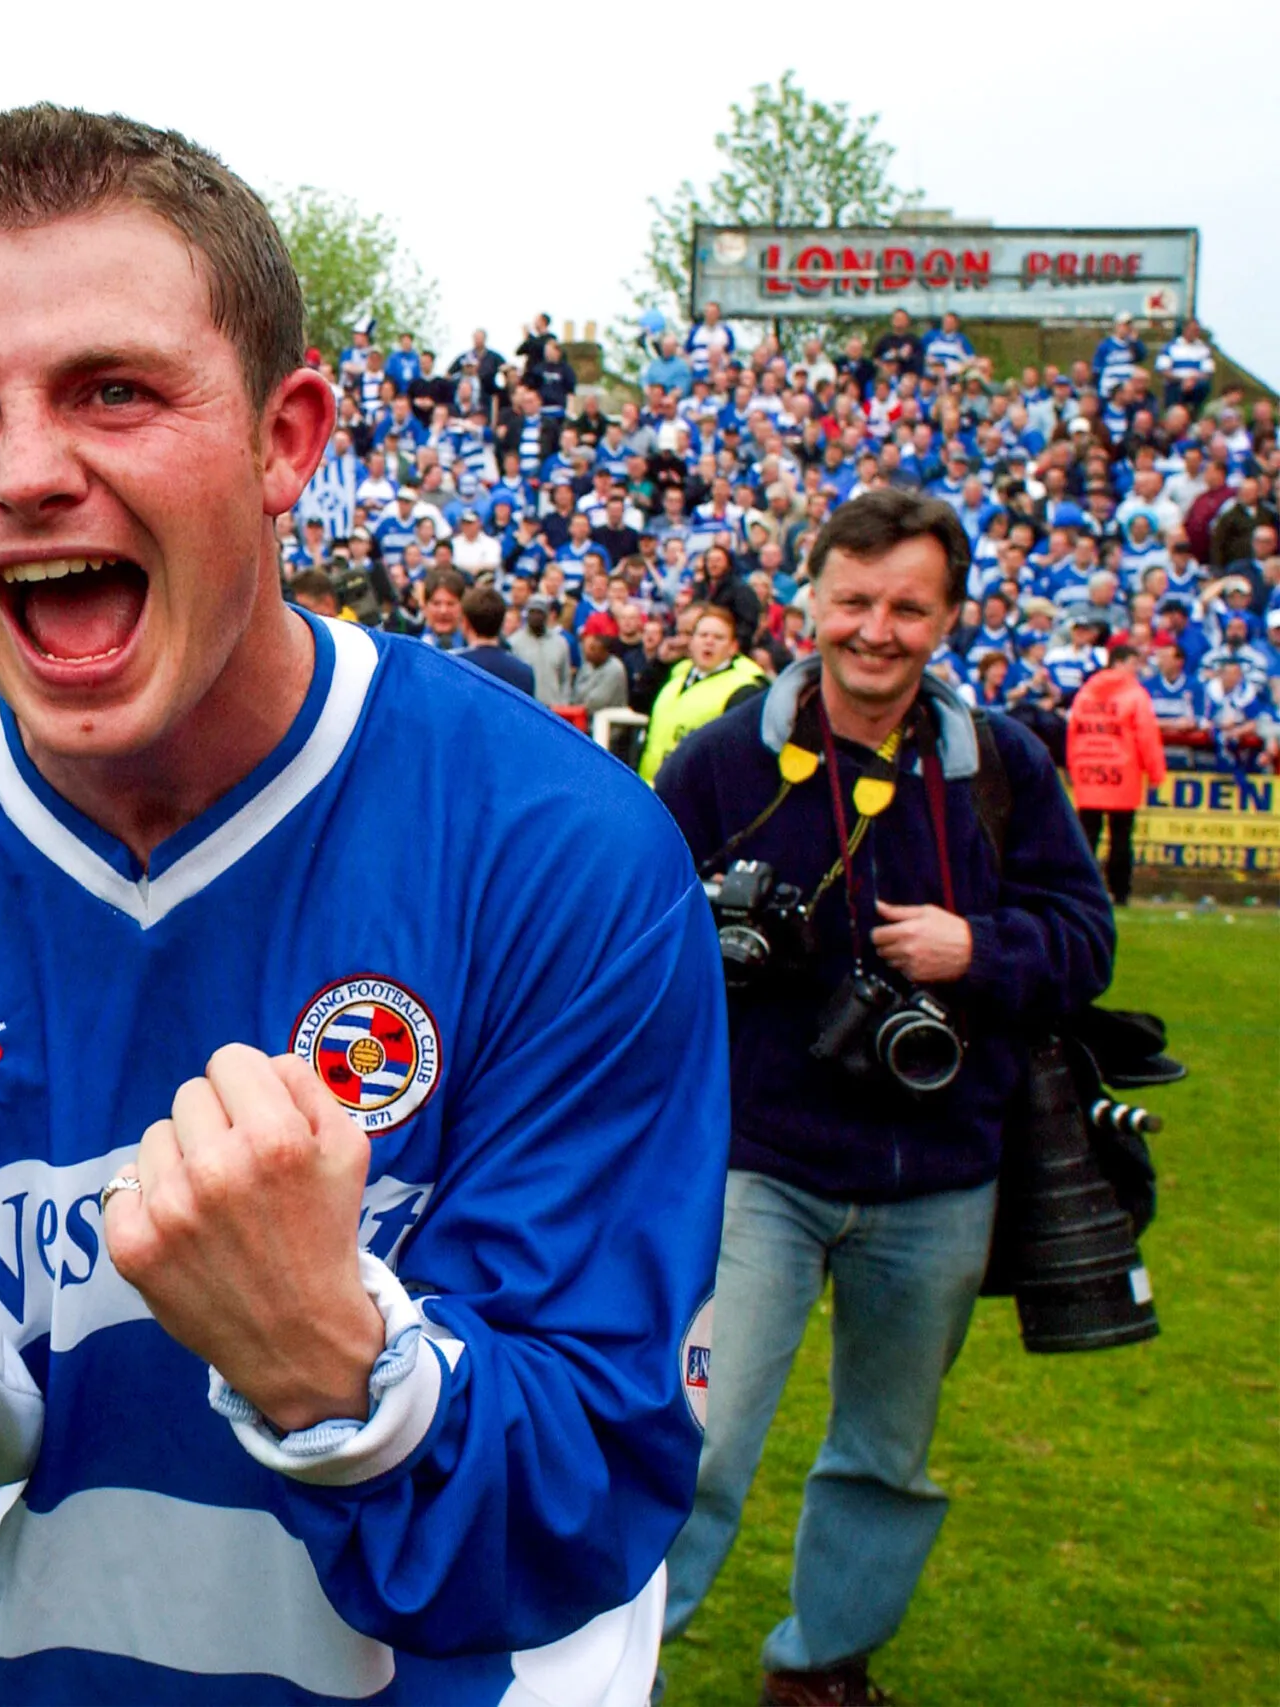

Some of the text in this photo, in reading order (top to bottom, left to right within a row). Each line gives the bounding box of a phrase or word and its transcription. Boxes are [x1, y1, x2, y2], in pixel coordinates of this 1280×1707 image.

[763, 245, 990, 295] LONDON
[1023, 251, 1141, 285] PRIDE
[347, 982, 422, 1032] FOOTBALL
[417, 1034, 434, 1084] CLUB
[365, 1111, 393, 1126] 1871
